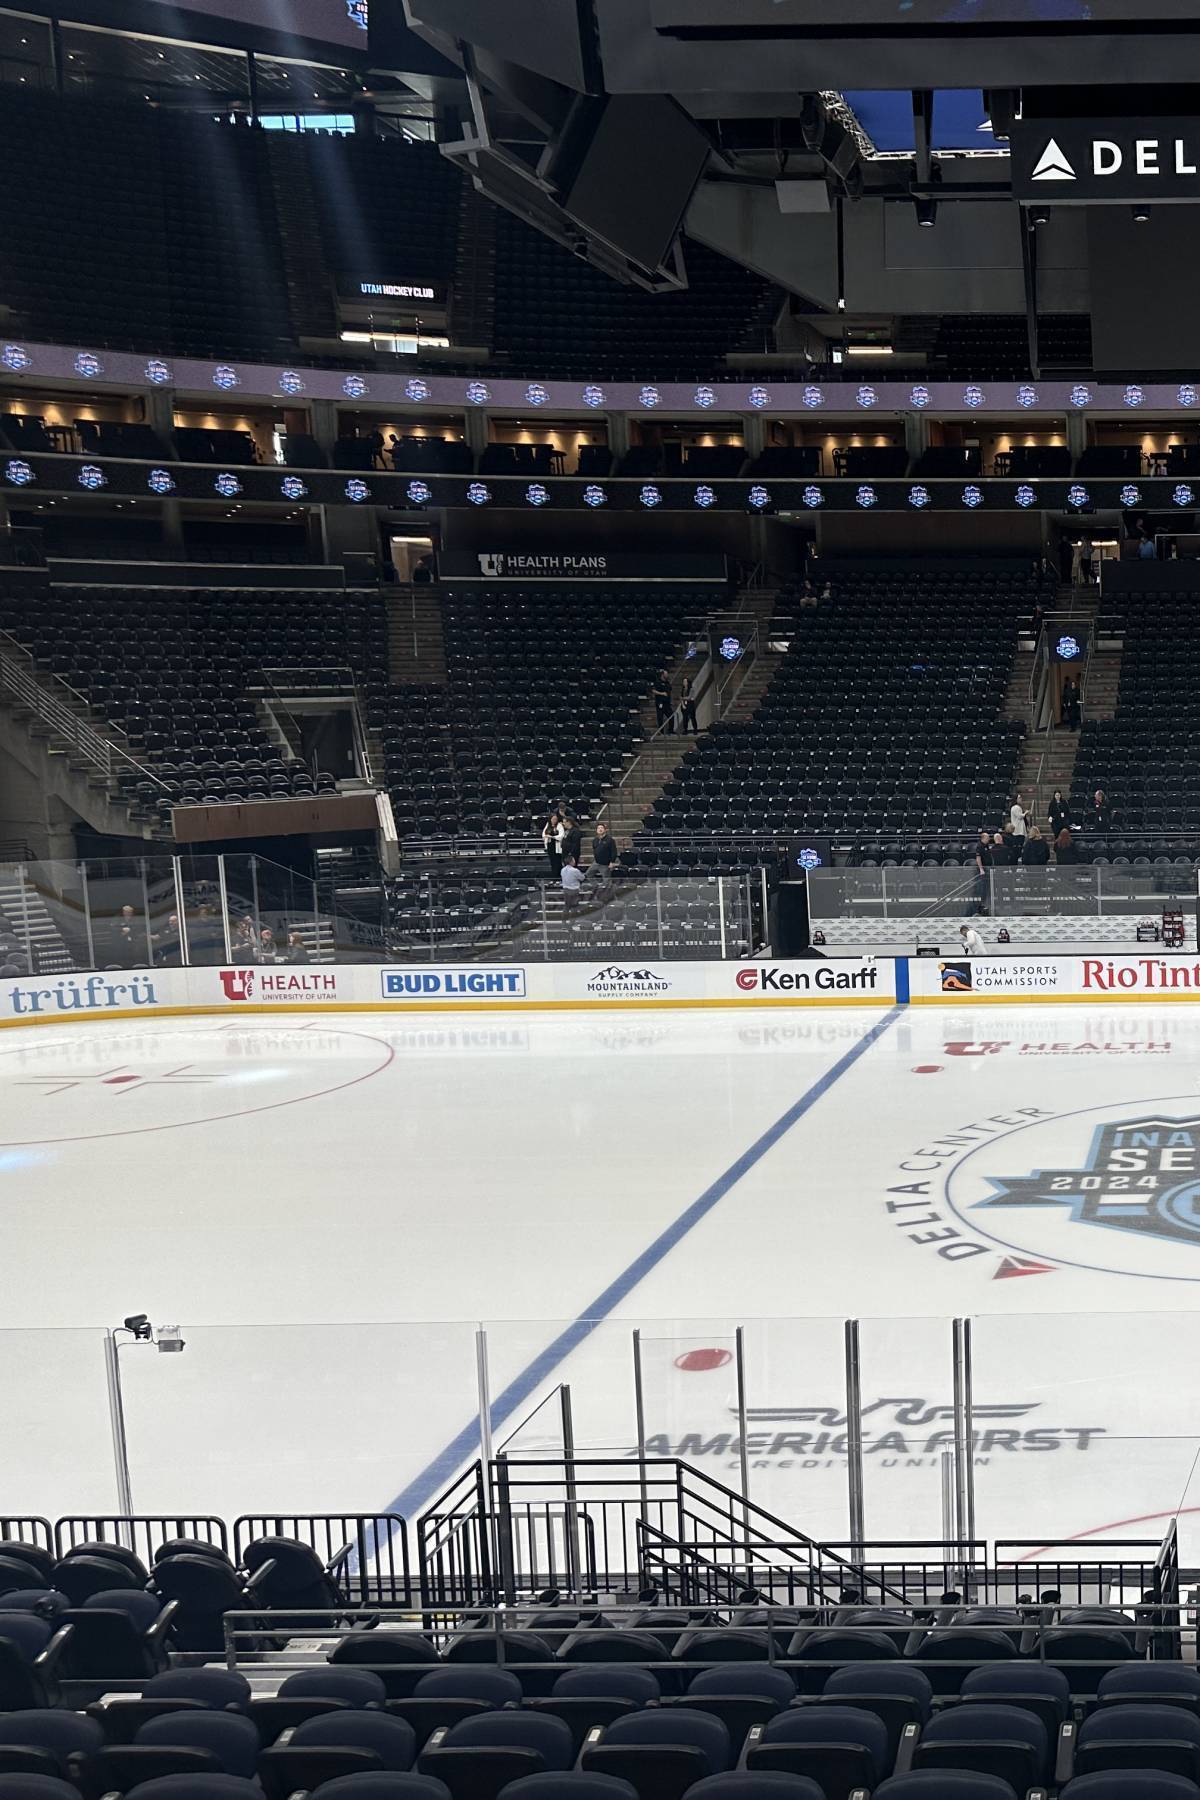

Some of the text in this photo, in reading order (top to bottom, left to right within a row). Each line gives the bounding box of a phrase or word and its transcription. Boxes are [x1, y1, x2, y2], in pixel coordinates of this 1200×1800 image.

[360, 283, 434, 299] UTAH HOCKEY CLUB
[507, 556, 559, 568] HEALTH
[563, 556, 607, 568] PLANS
[760, 968, 810, 990] Ken
[814, 967, 877, 990] Garff
[975, 965, 1058, 976] UTAH SPORTS
[261, 975, 336, 991] HEALTH
[386, 973, 520, 993] BUD LIGHT
[587, 982, 669, 991] MOUNTAINLAND
[975, 976, 1057, 987] COMMISSION
[8, 976, 158, 1014] trüfrü
[262, 993, 304, 1001] UNIVERSITY
[1020, 1041, 1172, 1051] HEALTH
[885, 1106, 1056, 1262] DELTA CENTER
[1049, 1174, 1161, 1192] 2024
[624, 1430, 911, 1456] AMERICA
[880, 1456, 991, 1468] UNIN
